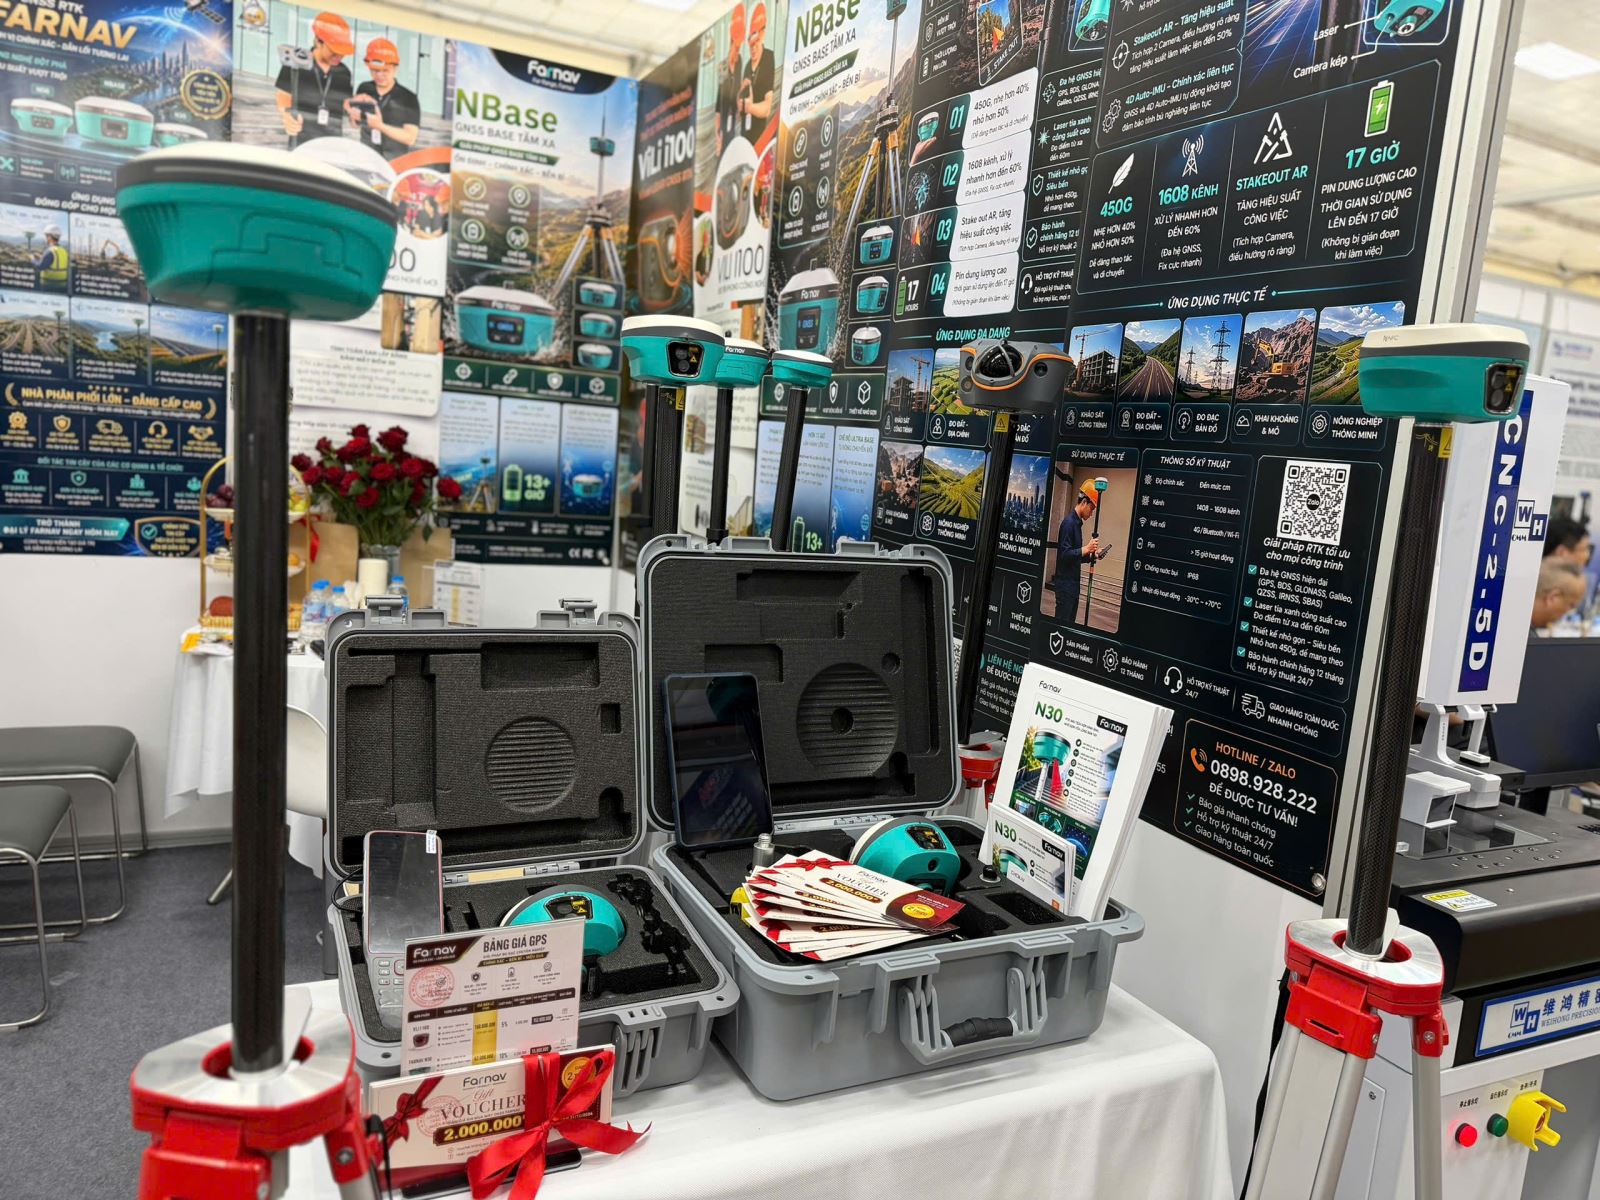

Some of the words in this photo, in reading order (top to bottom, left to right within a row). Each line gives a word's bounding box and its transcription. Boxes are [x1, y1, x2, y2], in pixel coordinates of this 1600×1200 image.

[795, 0, 860, 53] NBase
[1314, 25, 1339, 40] Laser
[793, 54, 811, 74] GNSS
[812, 44, 829, 64] BASE
[845, 28, 856, 45] XA
[1293, 59, 1328, 79] Camera
[1330, 54, 1348, 71] kép
[456, 88, 558, 132] NBase
[950, 103, 964, 130] 01
[455, 122, 485, 137] GNSS
[487, 129, 514, 142] BASE
[542, 138, 555, 149] XA
[1345, 147, 1367, 169] 17
[1370, 141, 1400, 165] GIỜ
[943, 163, 959, 187] 02
[1236, 169, 1291, 191] STAKEOUT
[1292, 165, 1309, 179] AR
[1321, 183, 1336, 194] PIN
[1338, 178, 1364, 191] DUNG
[1365, 171, 1396, 187] LƯỢNG
[1397, 166, 1417, 179] CAO
[1100, 196, 1133, 217] 450G
[1158, 185, 1189, 206] 1608
[1191, 184, 1219, 199] KÊNH
[1236, 200, 1258, 211] TĂNG
[1260, 196, 1279, 209] HIỆU
[1280, 189, 1302, 204] SUẤT
[1320, 201, 1343, 214] THỜI
[1344, 197, 1368, 210] GIAN
[1370, 192, 1382, 205] SỬ
[1384, 187, 1412, 203] DỤNG
[1154, 214, 1165, 225] XỬ
[1166, 213, 1174, 224] LÝ
[1175, 209, 1200, 222] NHANH
[1201, 207, 1218, 217] HƠN
[1243, 212, 1268, 225] CÔNG
[1269, 210, 1289, 221] VIỆC
[1327, 216, 1346, 229] LÊN
[1348, 212, 1367, 225] ĐẾN
[1370, 213, 1380, 223] 17
[1381, 206, 1399, 220] GIỜ
[937, 219, 952, 241] 03
[1168, 225, 1183, 238] ĐẾN
[1185, 225, 1200, 235] 60%
[908, 281, 920, 301] 17
[930, 271, 946, 296] 04
[1168, 296, 1189, 309] ỨNG
[1190, 294, 1220, 310] DỤNG
[1223, 291, 1251, 306] THỰC
[1254, 285, 1269, 301] TẾ
[1333, 417, 1354, 425] NÔNG
[1355, 417, 1383, 428] NGHIỆP
[1332, 430, 1356, 439] THÔNG
[1358, 430, 1378, 439] MINH
[1160, 456, 1184, 465] THÔNG
[1186, 455, 1195, 466] SỐ
[1197, 457, 1206, 467] KỸ
[1208, 458, 1231, 470] THUẬT
[524, 474, 551, 489] 13+
[1307, 498, 1320, 506] Zalo
[806, 532, 822, 551] 13+
[1263, 537, 1281, 548] Giải
[1282, 541, 1304, 551] pháp
[1306, 544, 1324, 554] RTK
[1325, 547, 1338, 556] tối
[1338, 550, 1351, 558] ưu
[1301, 557, 1321, 568] công
[1323, 559, 1344, 571] trình
[1035, 701, 1064, 723] N30
[1269, 702, 1285, 712] GIAO
[1285, 706, 1303, 719] HÀNG
[1304, 712, 1321, 724] TOÀN
[1321, 716, 1340, 731] QUỐC
[1267, 715, 1293, 728] NHANH
[1294, 723, 1319, 738] CHÓNG
[1215, 741, 1259, 766] HOTLINE
[1260, 758, 1266, 768] /
[1268, 760, 1296, 779] ZALO
[1211, 759, 1317, 814] 0898.928.222
[1209, 782, 1224, 796] ĐỂ
[1225, 789, 1255, 809] ĐƯỢC
[1257, 801, 1272, 815] TƯ
[1274, 808, 1298, 827] VẤN!
[1199, 797, 1213, 809] Báo
[1213, 804, 1225, 816] giá
[1226, 810, 1250, 826] nhanh
[1251, 820, 1277, 839] chóng
[995, 820, 1016, 842] N30
[1197, 810, 1208, 821] Hỗ
[1209, 817, 1220, 828] trợ
[1221, 821, 1231, 834] kỹ
[1232, 827, 1252, 842] thuật
[1254, 835, 1274, 851] 24/7
[1195, 824, 1212, 838] Giao
[1213, 832, 1232, 850] hàng
[1234, 843, 1252, 857] toàn
[1253, 852, 1274, 867] quốc
[837, 873, 890, 897] VOUCHER
[484, 937, 509, 952] BẢNG
[512, 934, 528, 948] GIÁ
[529, 934, 547, 946] GPS
[463, 1073, 507, 1087] Farnav
